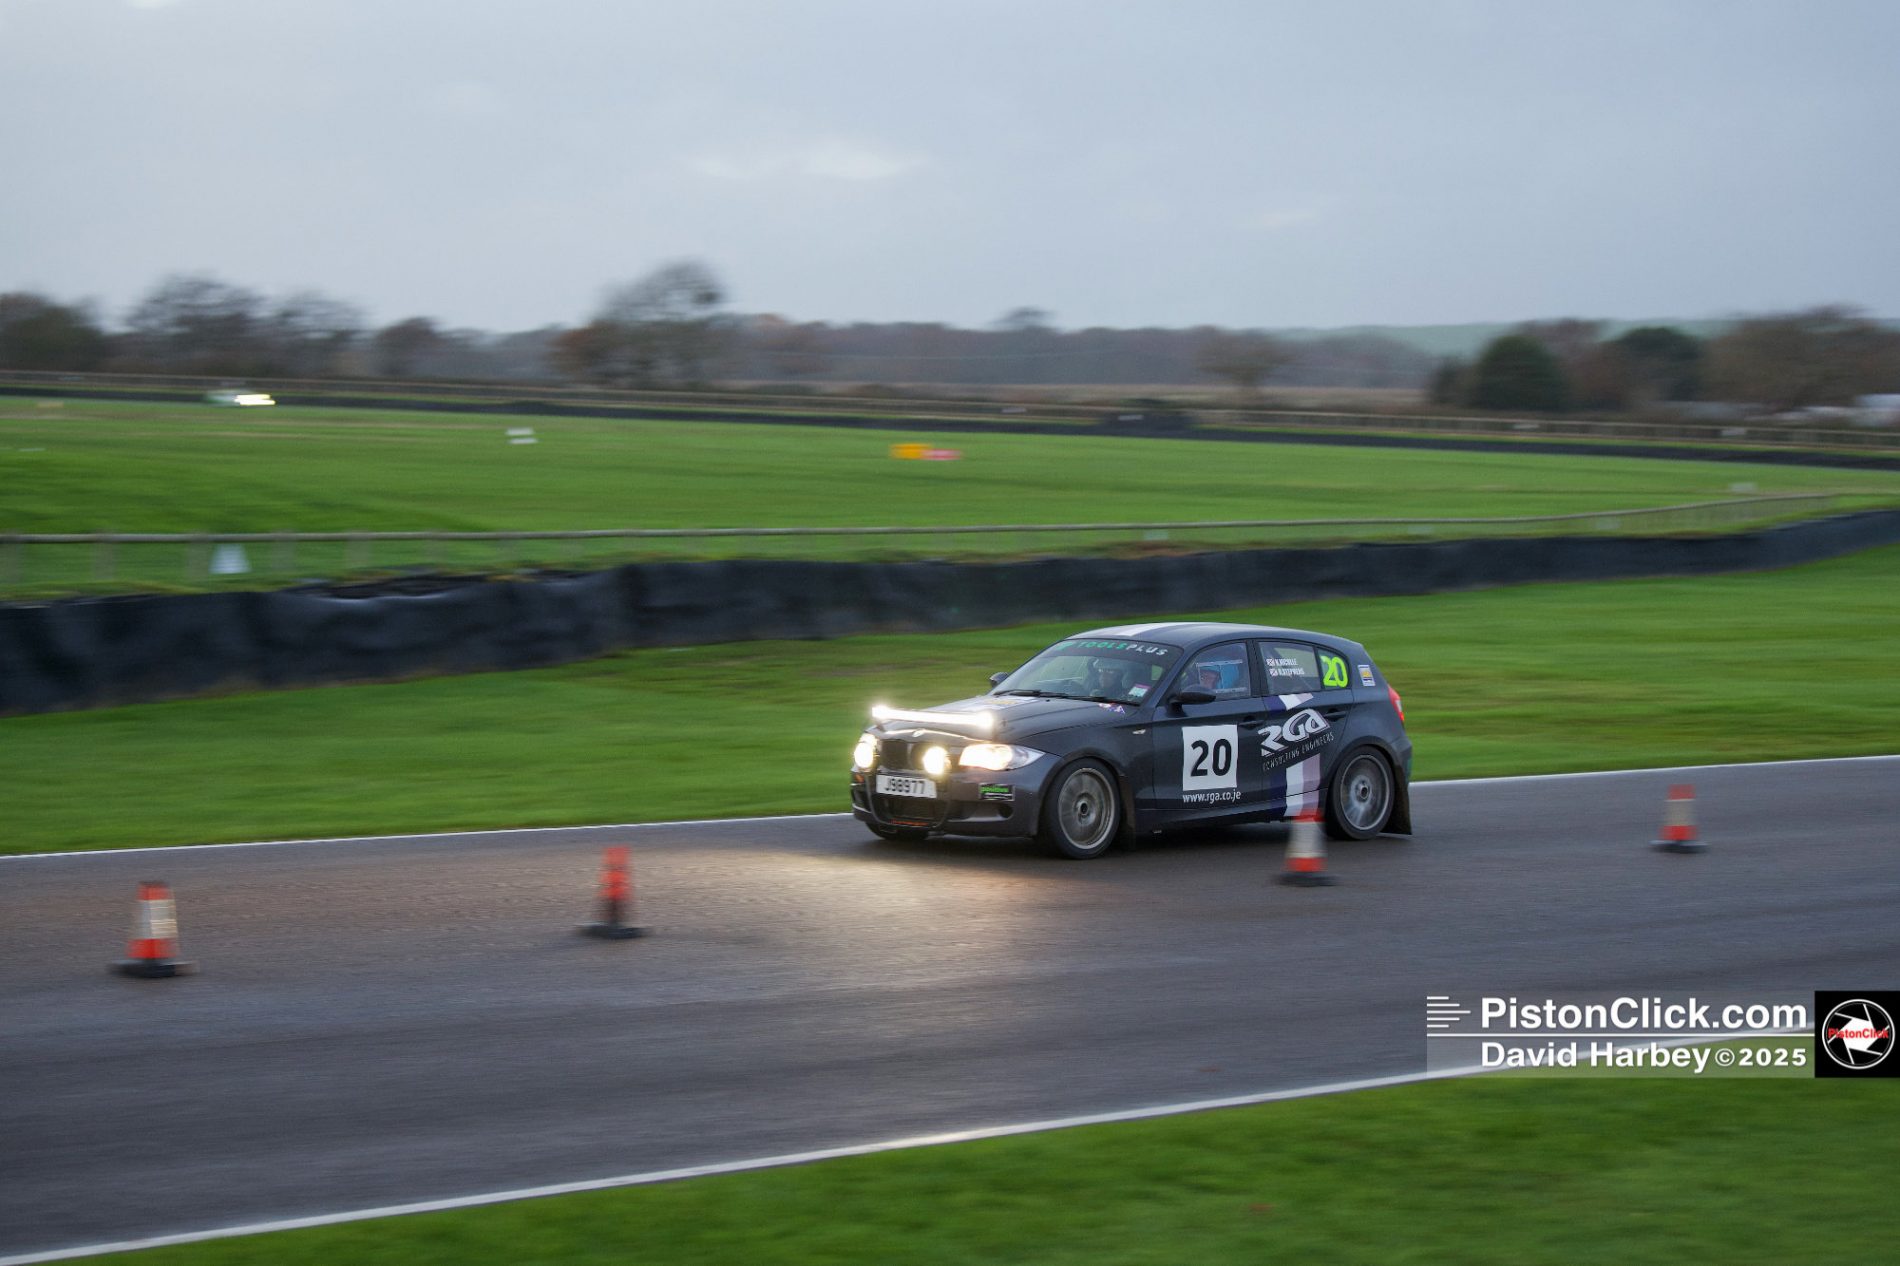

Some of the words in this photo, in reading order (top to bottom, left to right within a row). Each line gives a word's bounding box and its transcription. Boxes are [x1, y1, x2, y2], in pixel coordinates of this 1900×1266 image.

[1320, 655, 1349, 688] 20
[1302, 732, 1335, 754] ENGINEERS
[1191, 738, 1232, 777] 20
[1182, 789, 1242, 804] www.rga.co.je
